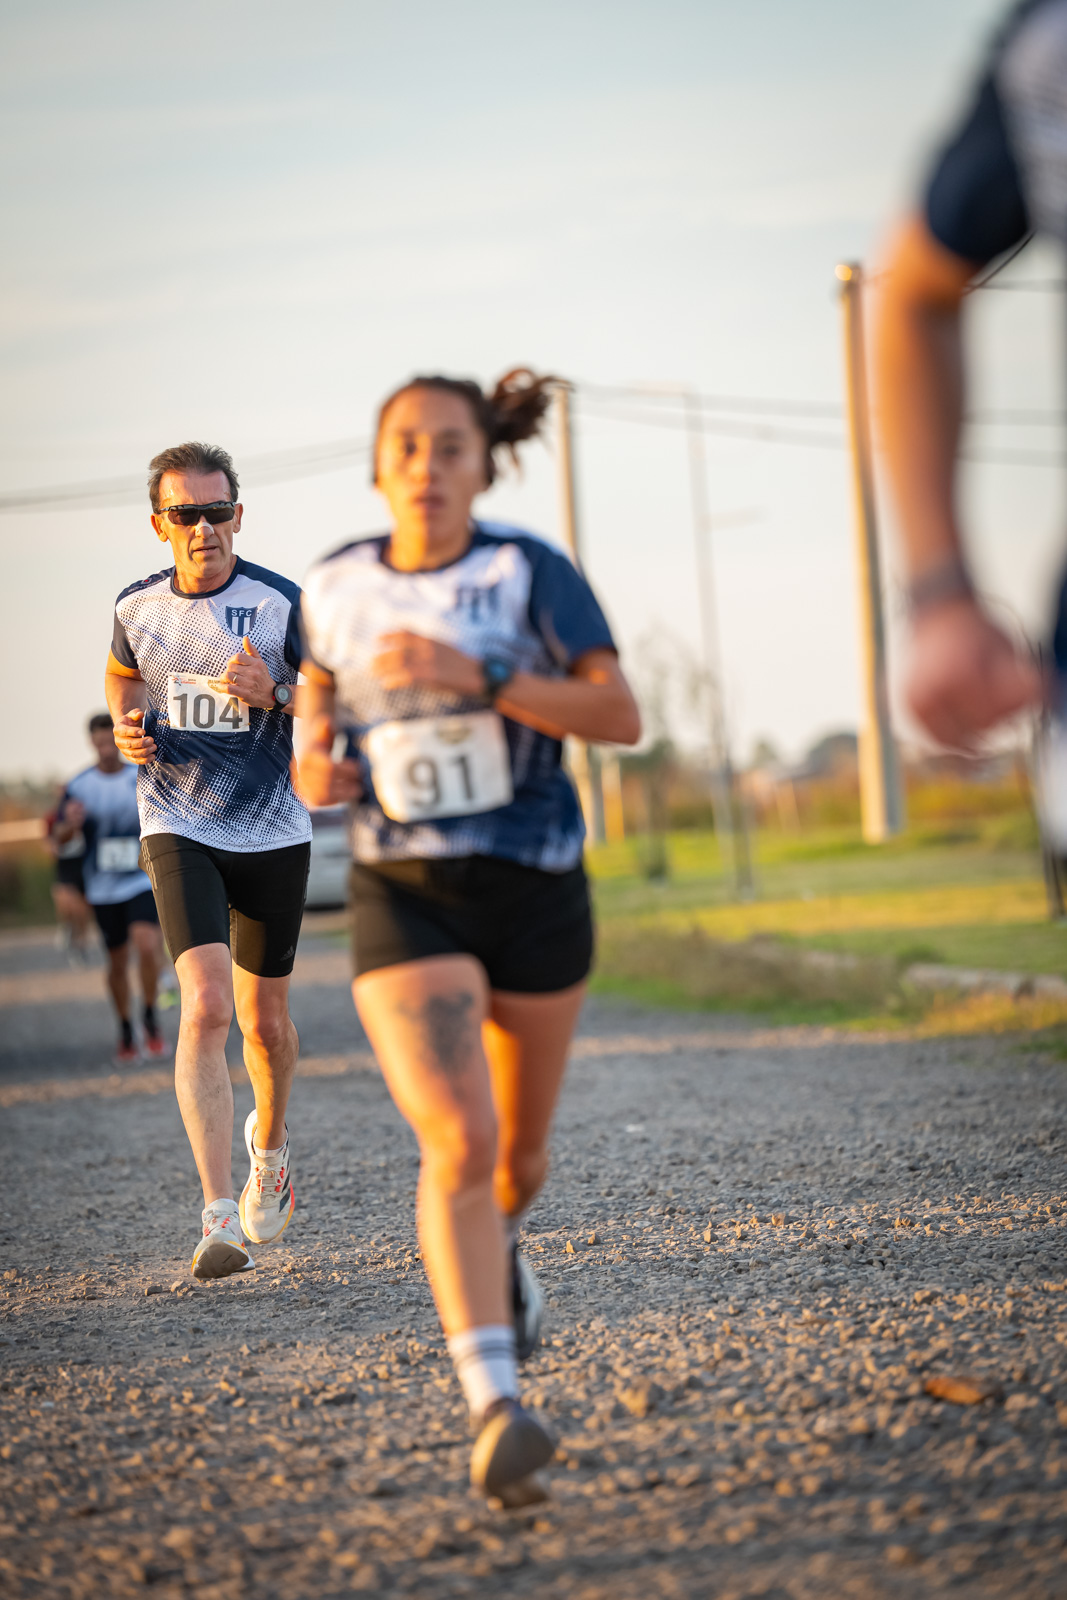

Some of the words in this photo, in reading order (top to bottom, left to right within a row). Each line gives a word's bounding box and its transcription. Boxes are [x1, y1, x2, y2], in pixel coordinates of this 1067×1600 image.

[231, 609, 252, 617] SFC
[173, 693, 243, 729] 104
[407, 755, 475, 808] 91
